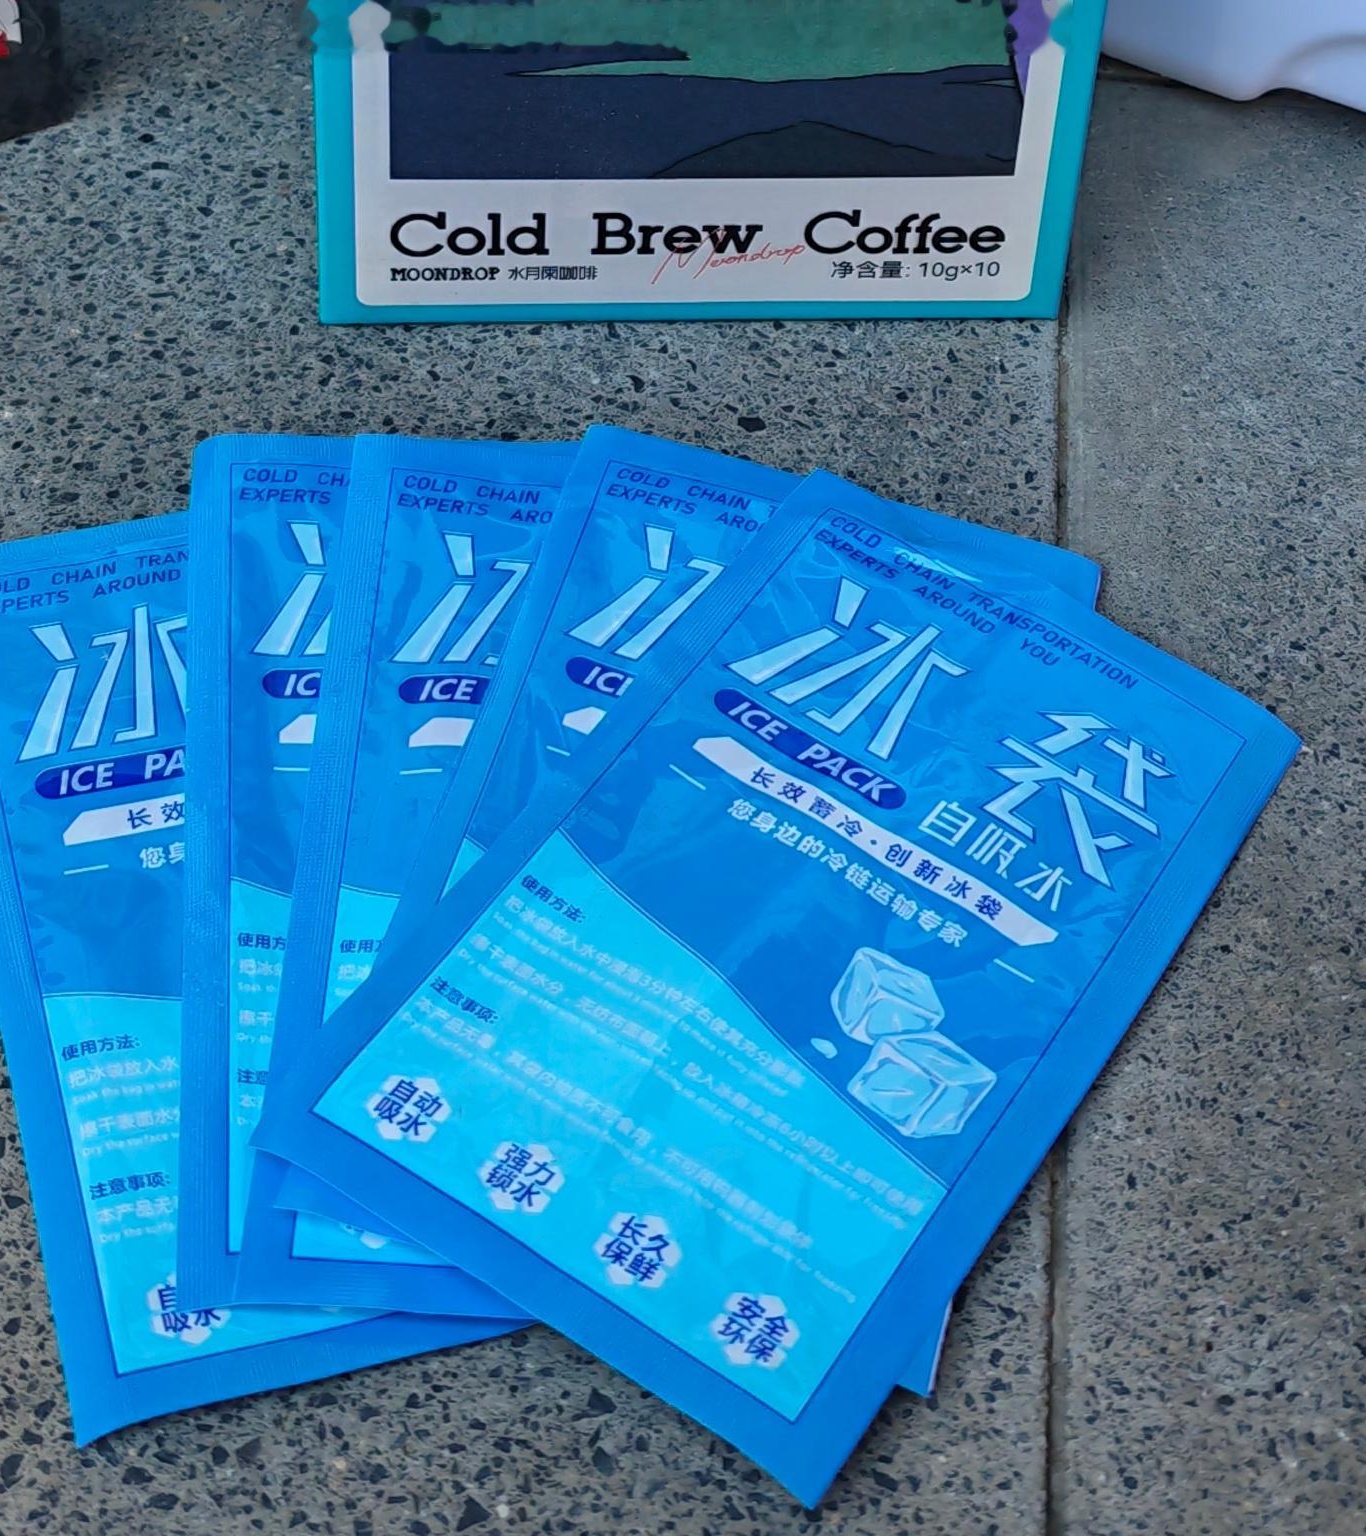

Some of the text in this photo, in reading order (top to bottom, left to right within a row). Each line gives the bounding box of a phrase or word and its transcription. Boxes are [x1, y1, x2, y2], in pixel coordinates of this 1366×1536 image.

[390, 210, 1006, 257] Cold Brew Coffee
[390, 267, 501, 281] MOONDROP
[242, 467, 298, 484] COLD
[403, 474, 541, 505] COLD CHAIN
[616, 467, 671, 489] COLD
[686, 485, 752, 512] CHAIN
[239, 487, 332, 505] EXPERTS
[397, 493, 489, 517] EXPERTS
[607, 483, 698, 515] EXPERTS
[51, 561, 117, 586] CHAIN
[92, 569, 182, 599] AROUND
[814, 528, 1061, 668] EXPERTS AROUND YOU
[830, 515, 1141, 691] COLD CHAIN TRANSPORTATION
[418, 677, 479, 702] ICE
[728, 700, 898, 804] ICE PACK
[59, 762, 115, 796] ICE
[727, 798, 968, 948] 您身边的冷链运输专家
[918, 800, 1073, 912] 自吸水
[61, 1033, 141, 1061] 使用方法:
[373, 1096, 428, 1136] 吸水
[389, 1079, 444, 1118] 自动
[485, 1163, 541, 1207] 锁水
[500, 1143, 556, 1187] 强力
[89, 1171, 171, 1200] 注意事项:
[617, 1215, 669, 1261] 长久
[601, 1237, 662, 1282] 保鲜
[717, 1316, 777, 1363] 环保
[731, 1296, 790, 1344] 安全
